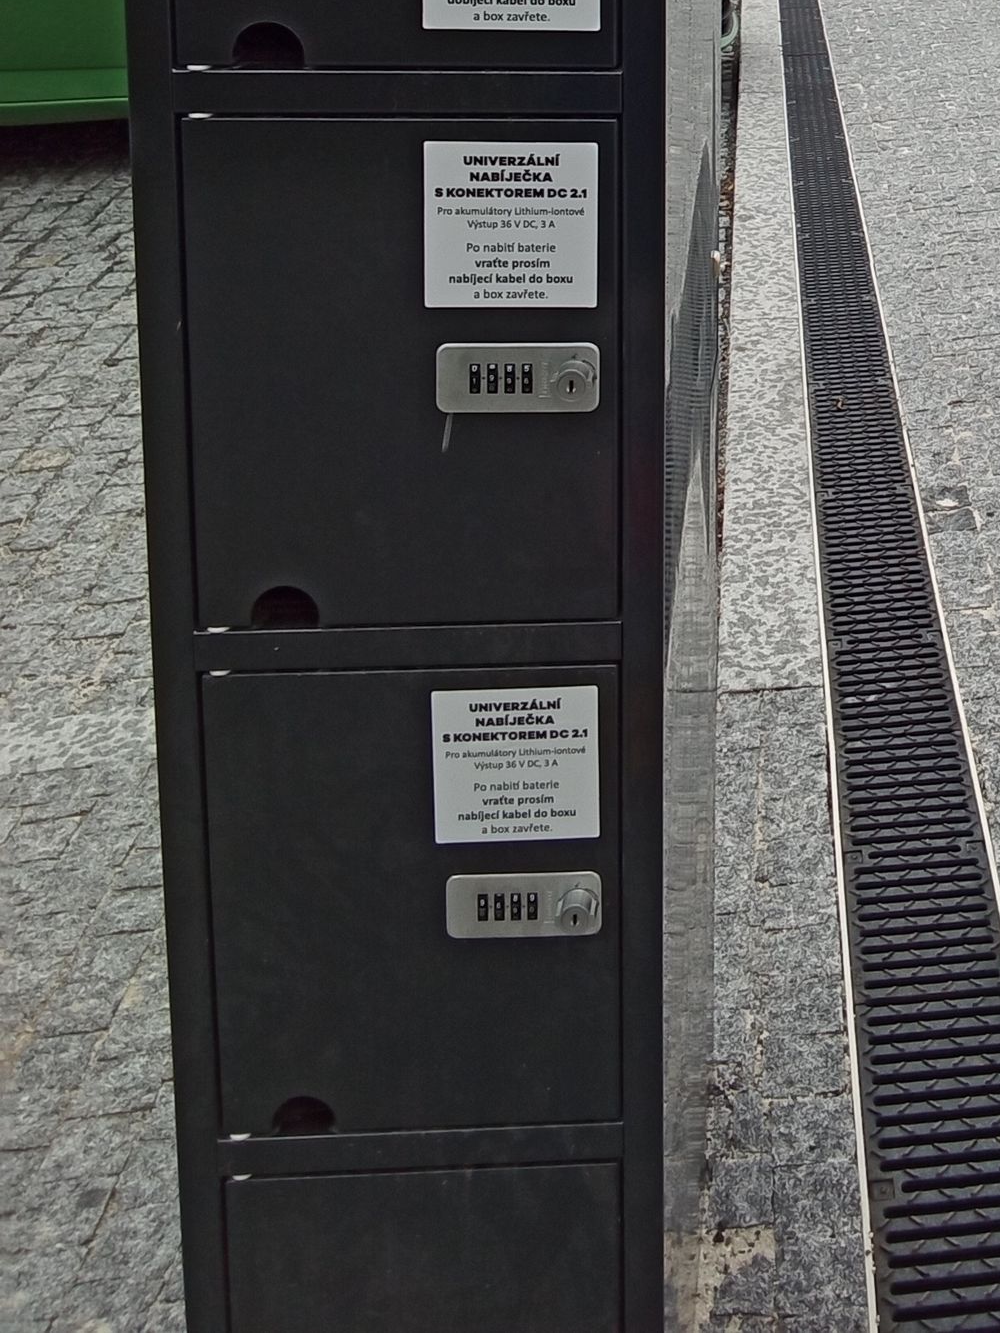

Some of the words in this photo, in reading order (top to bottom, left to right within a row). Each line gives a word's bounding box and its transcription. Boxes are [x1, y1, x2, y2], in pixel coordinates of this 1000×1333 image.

[472, 12, 480, 21] a
[483, 10, 503, 21] box
[506, 10, 550, 22] zavřete.
[463, 153, 560, 167] UNIVERZÁLNÍ
[470, 169, 552, 182] NABÍJEČKA
[434, 187, 443, 197] S
[445, 187, 544, 198] KONEKTOREM
[546, 188, 567, 198] DC
[569, 188, 587, 198] 2.1
[437, 206, 454, 215] Pro
[454, 206, 512, 217] akumulátory
[514, 206, 584, 216] Lithium-iontové
[466, 219, 498, 230] Výstup
[500, 219, 512, 228] 36
[513, 219, 521, 228] V
[522, 219, 538, 229] DC,
[540, 219, 546, 228] 3
[547, 219, 555, 228] A
[466, 242, 480, 252] Po
[483, 241, 515, 252] nabití
[517, 242, 556, 253] baterie
[474, 256, 508, 268] vraťte
[511, 257, 551, 270] prosím
[448, 272, 493, 285] nabíjecí
[495, 272, 525, 283] kabel
[528, 273, 543, 283] do
[545, 273, 573, 284] boxu
[473, 291, 480, 299] a
[483, 288, 503, 299] box
[505, 288, 548, 299] zavřete.
[469, 698, 561, 713] UNIVERZÁLNÍ
[475, 713, 554, 727] NABÍJEČKA
[442, 733, 451, 743] S
[452, 729, 547, 743] KONEKTOREM
[549, 729, 569, 739] DC
[571, 728, 587, 738] 2.1
[445, 750, 460, 759] Pro
[461, 748, 516, 760] akumulátory
[518, 745, 585, 756] Lithium-iontové
[473, 760, 503, 771] Výstup
[505, 760, 517, 768] 36
[518, 759, 525, 768] V
[543, 758, 549, 767] 3
[551, 758, 558, 767] A
[473, 782, 487, 792] Po
[489, 780, 520, 791] nabití
[522, 779, 559, 790] baterie
[481, 794, 514, 806] vraťte
[517, 793, 554, 806] prosím
[457, 809, 500, 823] nabíjecí
[501, 808, 531, 819] kabel
[533, 807, 547, 818] do
[550, 806, 576, 817] boxu
[481, 826, 487, 834] a
[490, 823, 509, 833] box
[512, 822, 552, 833] zavřete.
